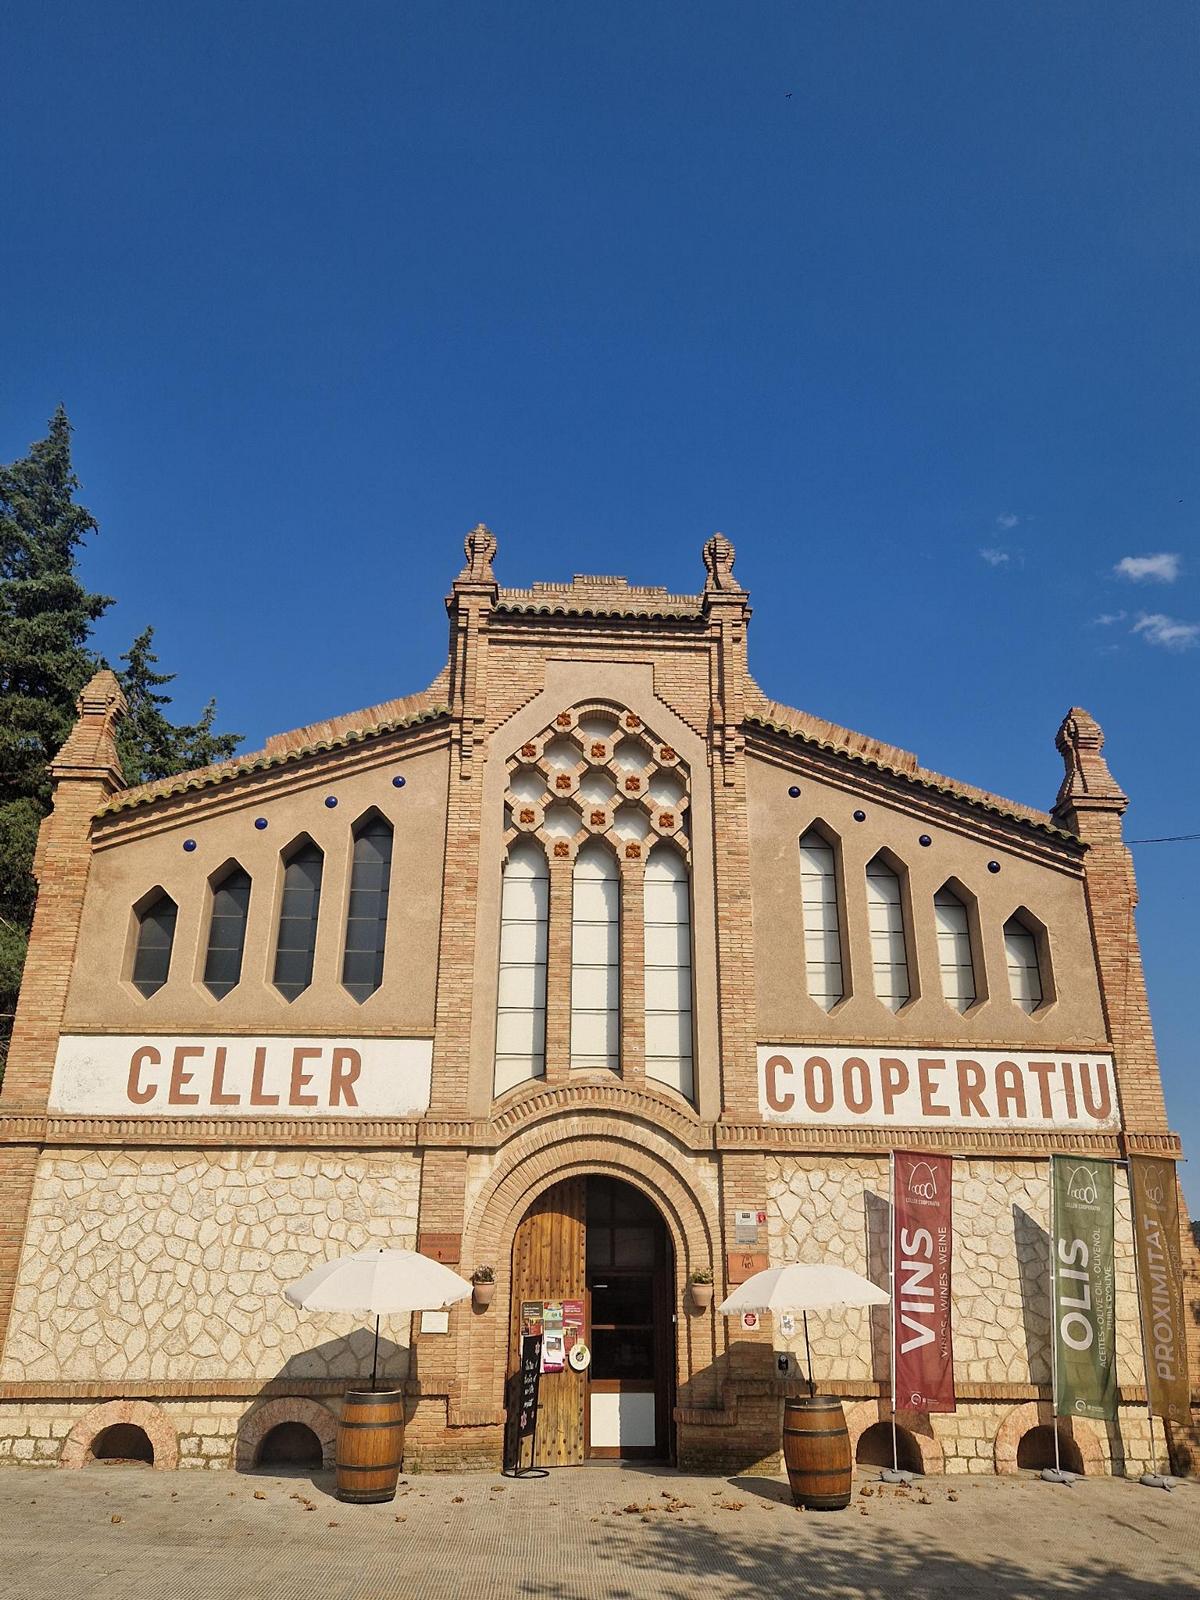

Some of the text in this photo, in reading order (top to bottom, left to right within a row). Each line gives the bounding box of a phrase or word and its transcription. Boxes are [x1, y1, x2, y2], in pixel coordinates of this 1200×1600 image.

[127, 1046, 361, 1107] CELLER
[764, 1054, 1112, 1119] COOPERATIU
[938, 1226, 947, 1265] WEINE
[901, 1227, 935, 1354] VINS
[939, 1273, 948, 1311] WINES
[1058, 1238, 1094, 1351] OLIS
[1094, 1280, 1103, 1295] OIL
[1095, 1298, 1104, 1324] OLIVE
[1143, 1214, 1176, 1381] PROXIMITAT
[1098, 1331, 1106, 1368] ACEITES
